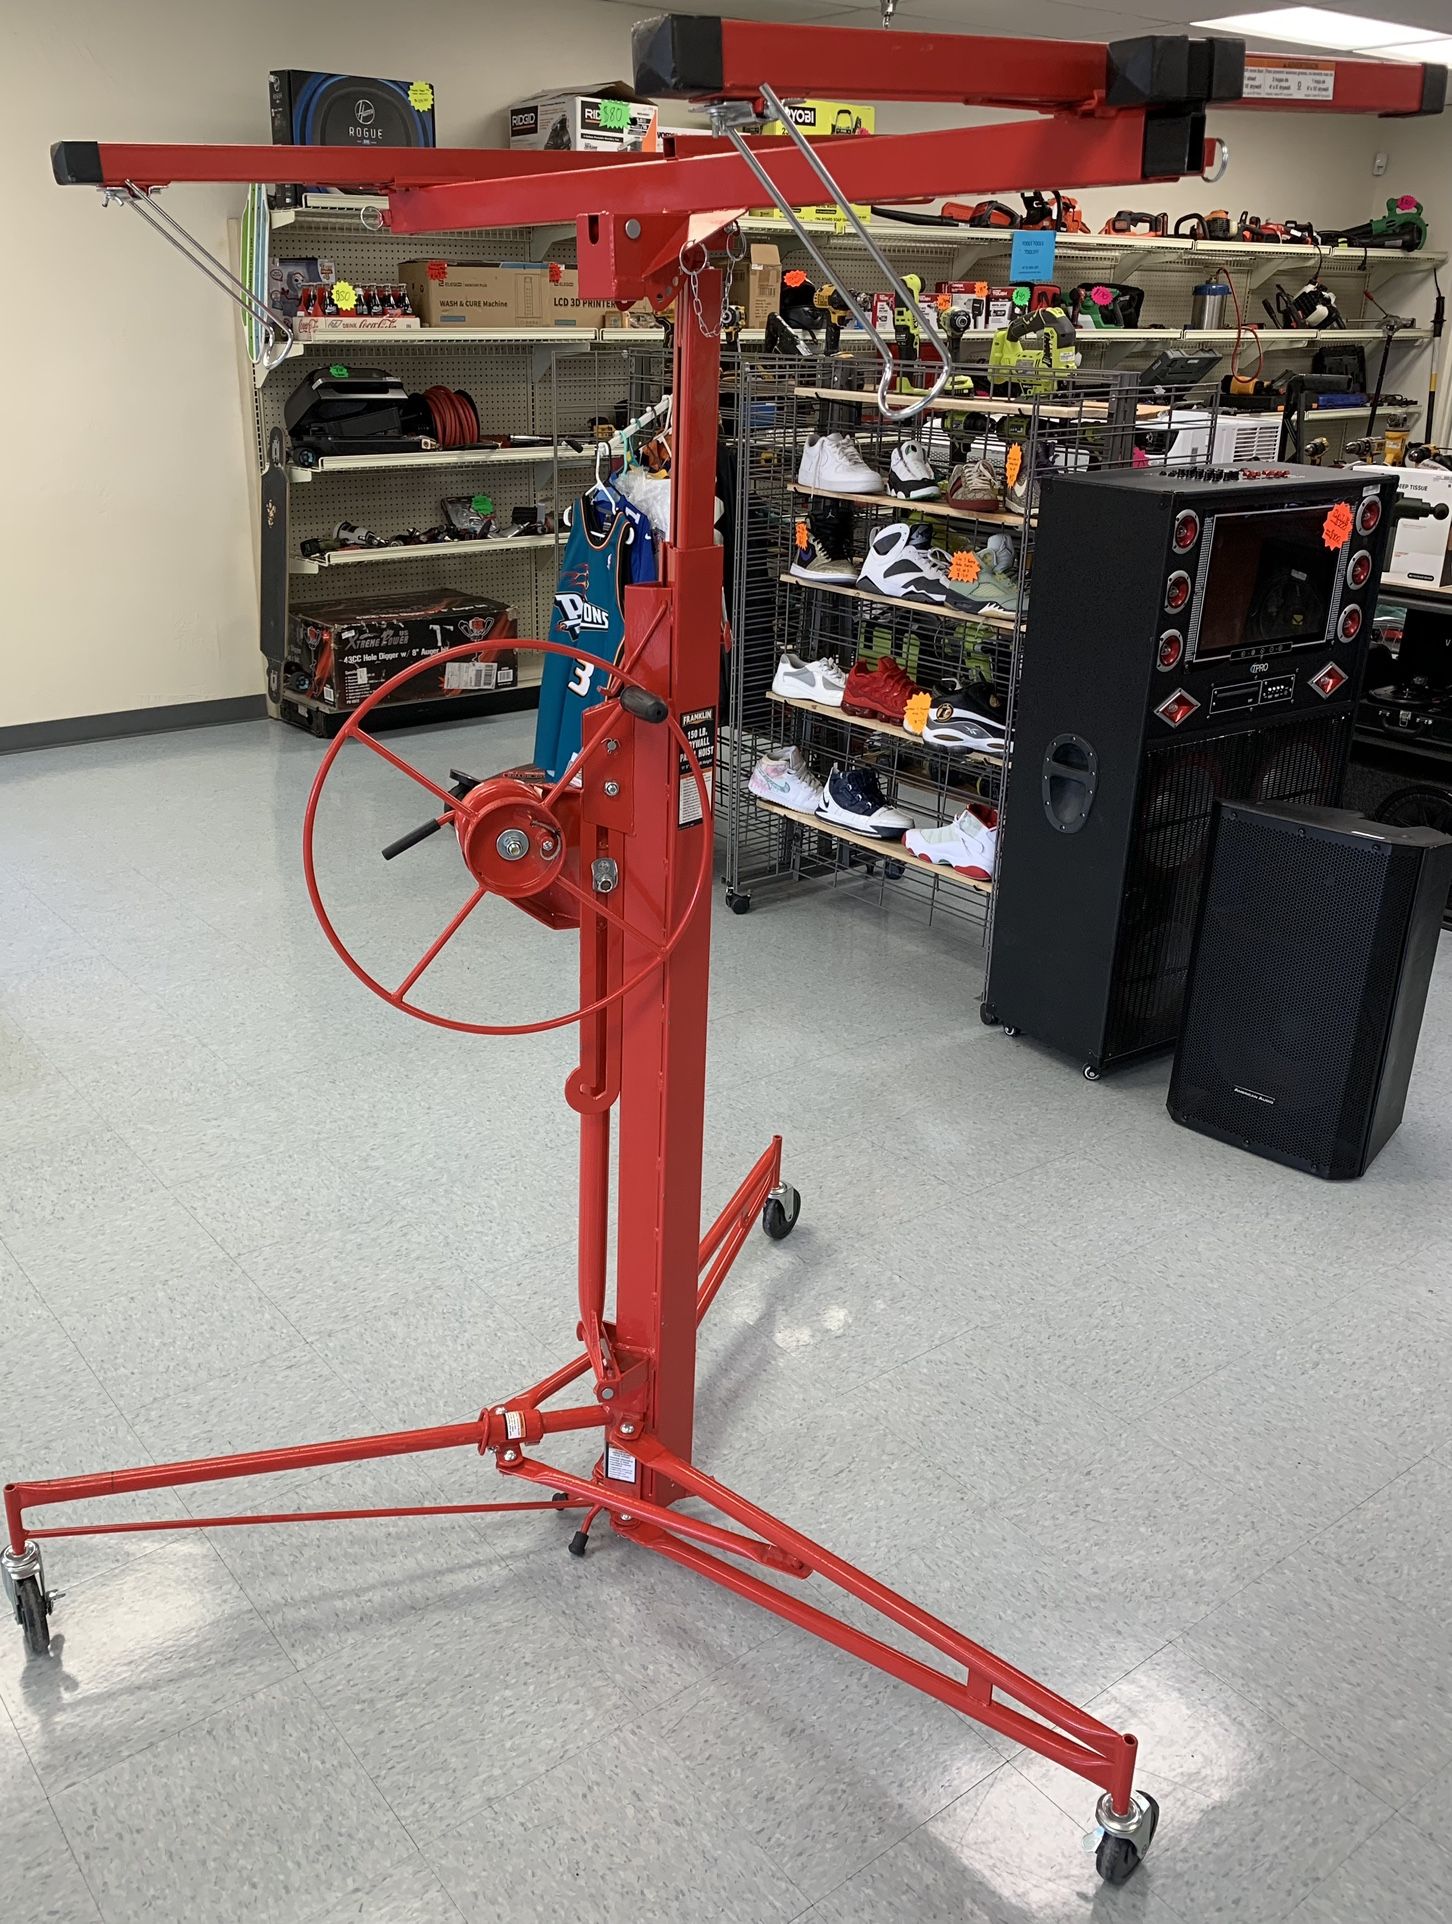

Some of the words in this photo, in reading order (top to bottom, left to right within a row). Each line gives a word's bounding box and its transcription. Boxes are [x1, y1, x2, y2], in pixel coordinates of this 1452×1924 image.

[512, 113, 536, 126] RIDGID
[585, 108, 600, 121] RID
[602, 106, 622, 124] $80
[349, 127, 382, 139] ROGUE
[482, 300, 508, 308] Machine
[554, 298, 568, 307] LCD
[570, 298, 581, 308] 3D
[582, 300, 616, 309] PRINTER
[1410, 484, 1428, 492] TISSUE
[345, 629, 380, 650] XTREME
[381, 629, 409, 646] POWER
[344, 654, 362, 664] 43CC
[363, 653, 378, 662] Hole
[379, 651, 399, 661] Digger
[421, 647, 439, 656] Auger
[567, 657, 595, 698] 3
[683, 710, 712, 725] FRANKLIN
[687, 730, 698, 740] 150
[689, 737, 710, 749] YWALL
[698, 746, 714, 759] HOIST
